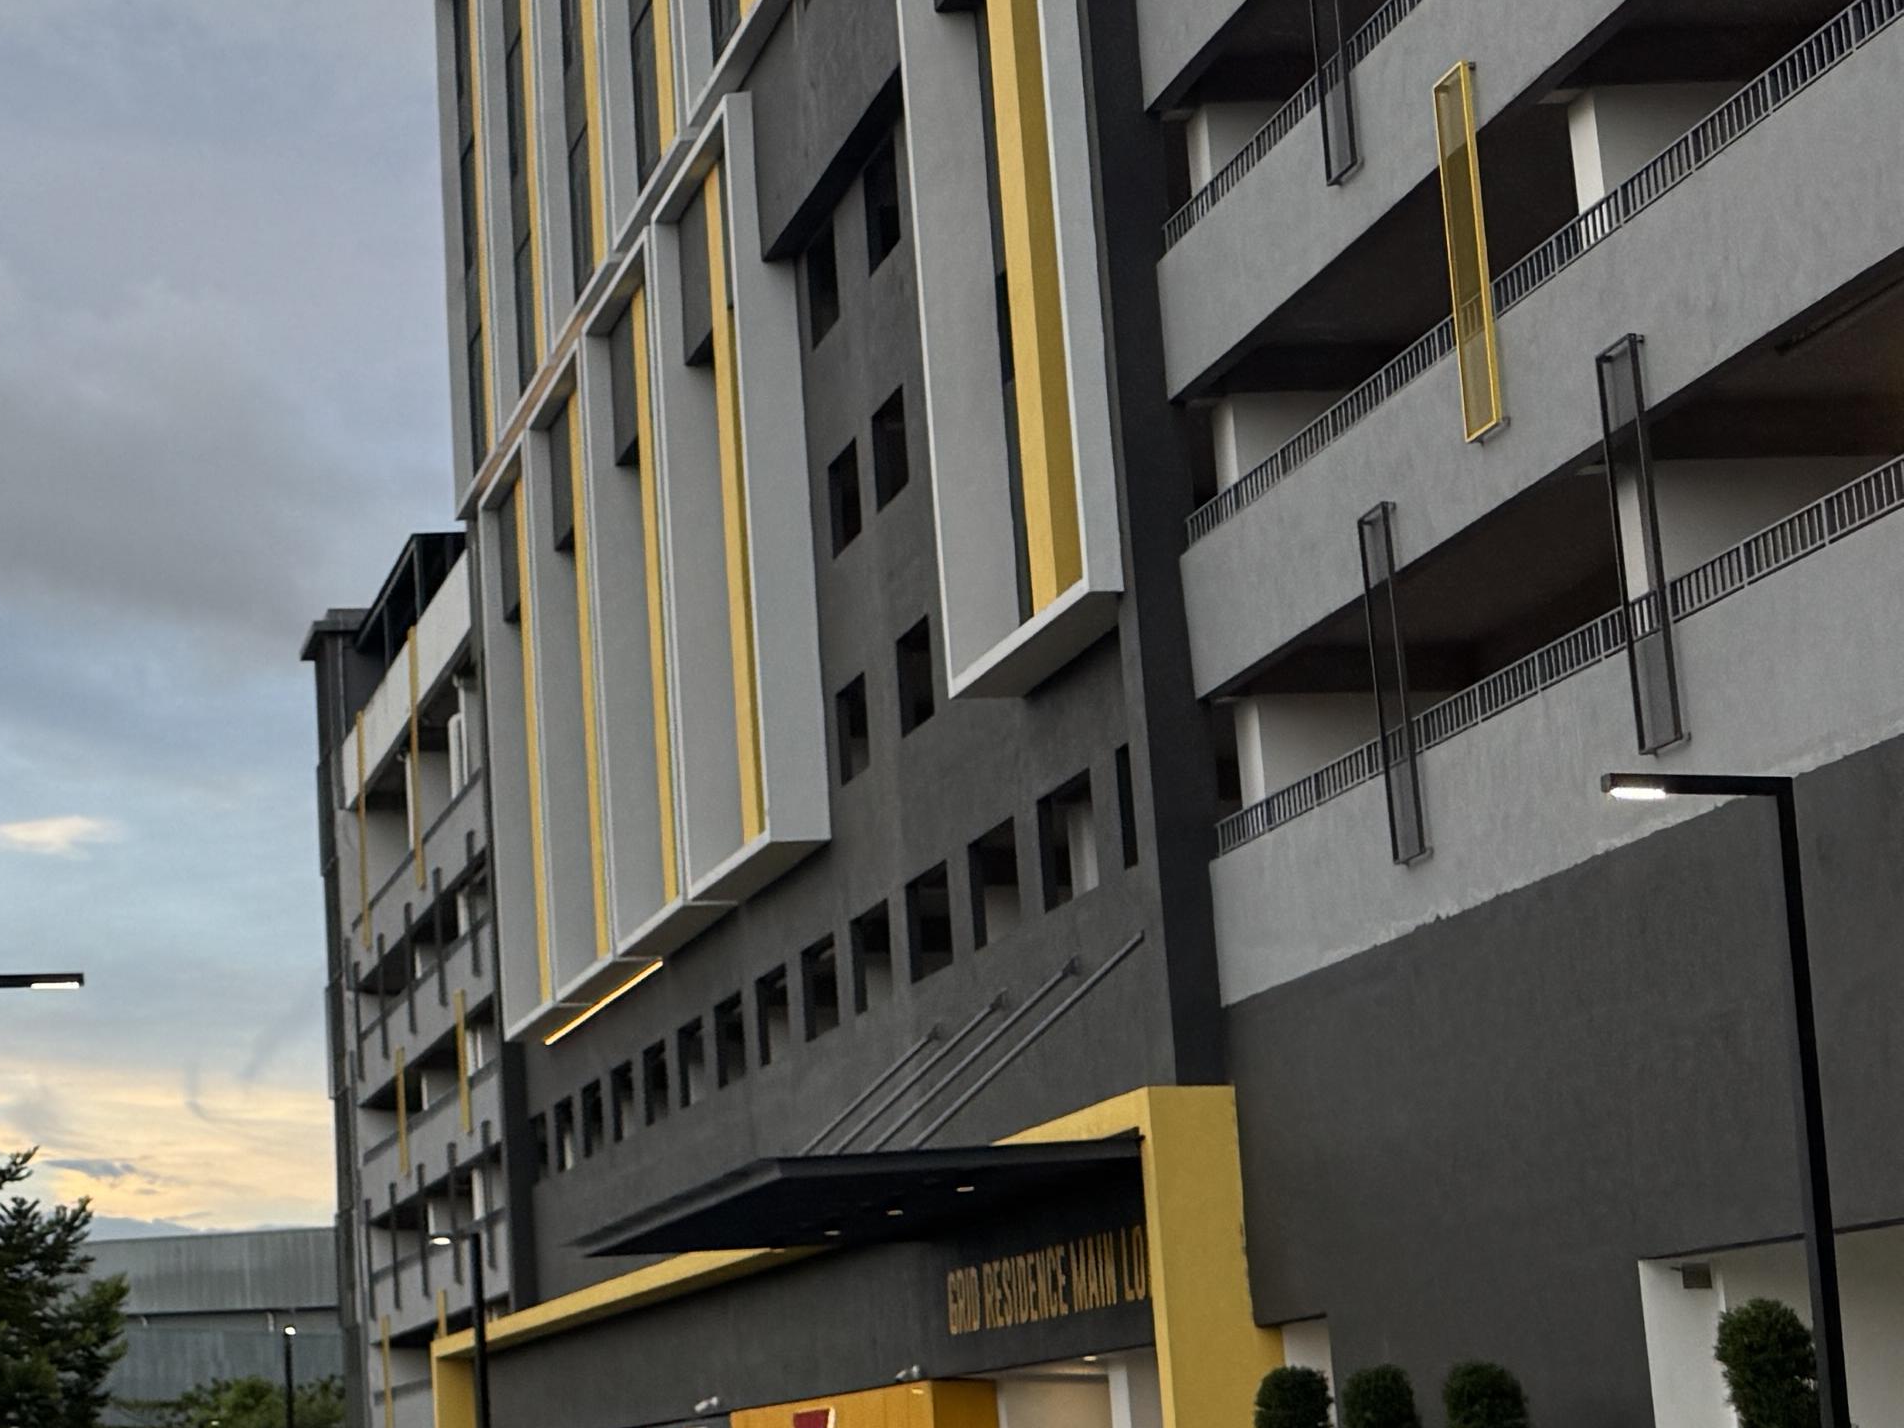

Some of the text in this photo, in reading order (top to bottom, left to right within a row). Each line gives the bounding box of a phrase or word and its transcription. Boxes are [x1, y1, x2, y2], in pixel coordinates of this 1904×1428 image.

[948, 1225, 1148, 1335] GRID RESIDENCE MAIN LO
